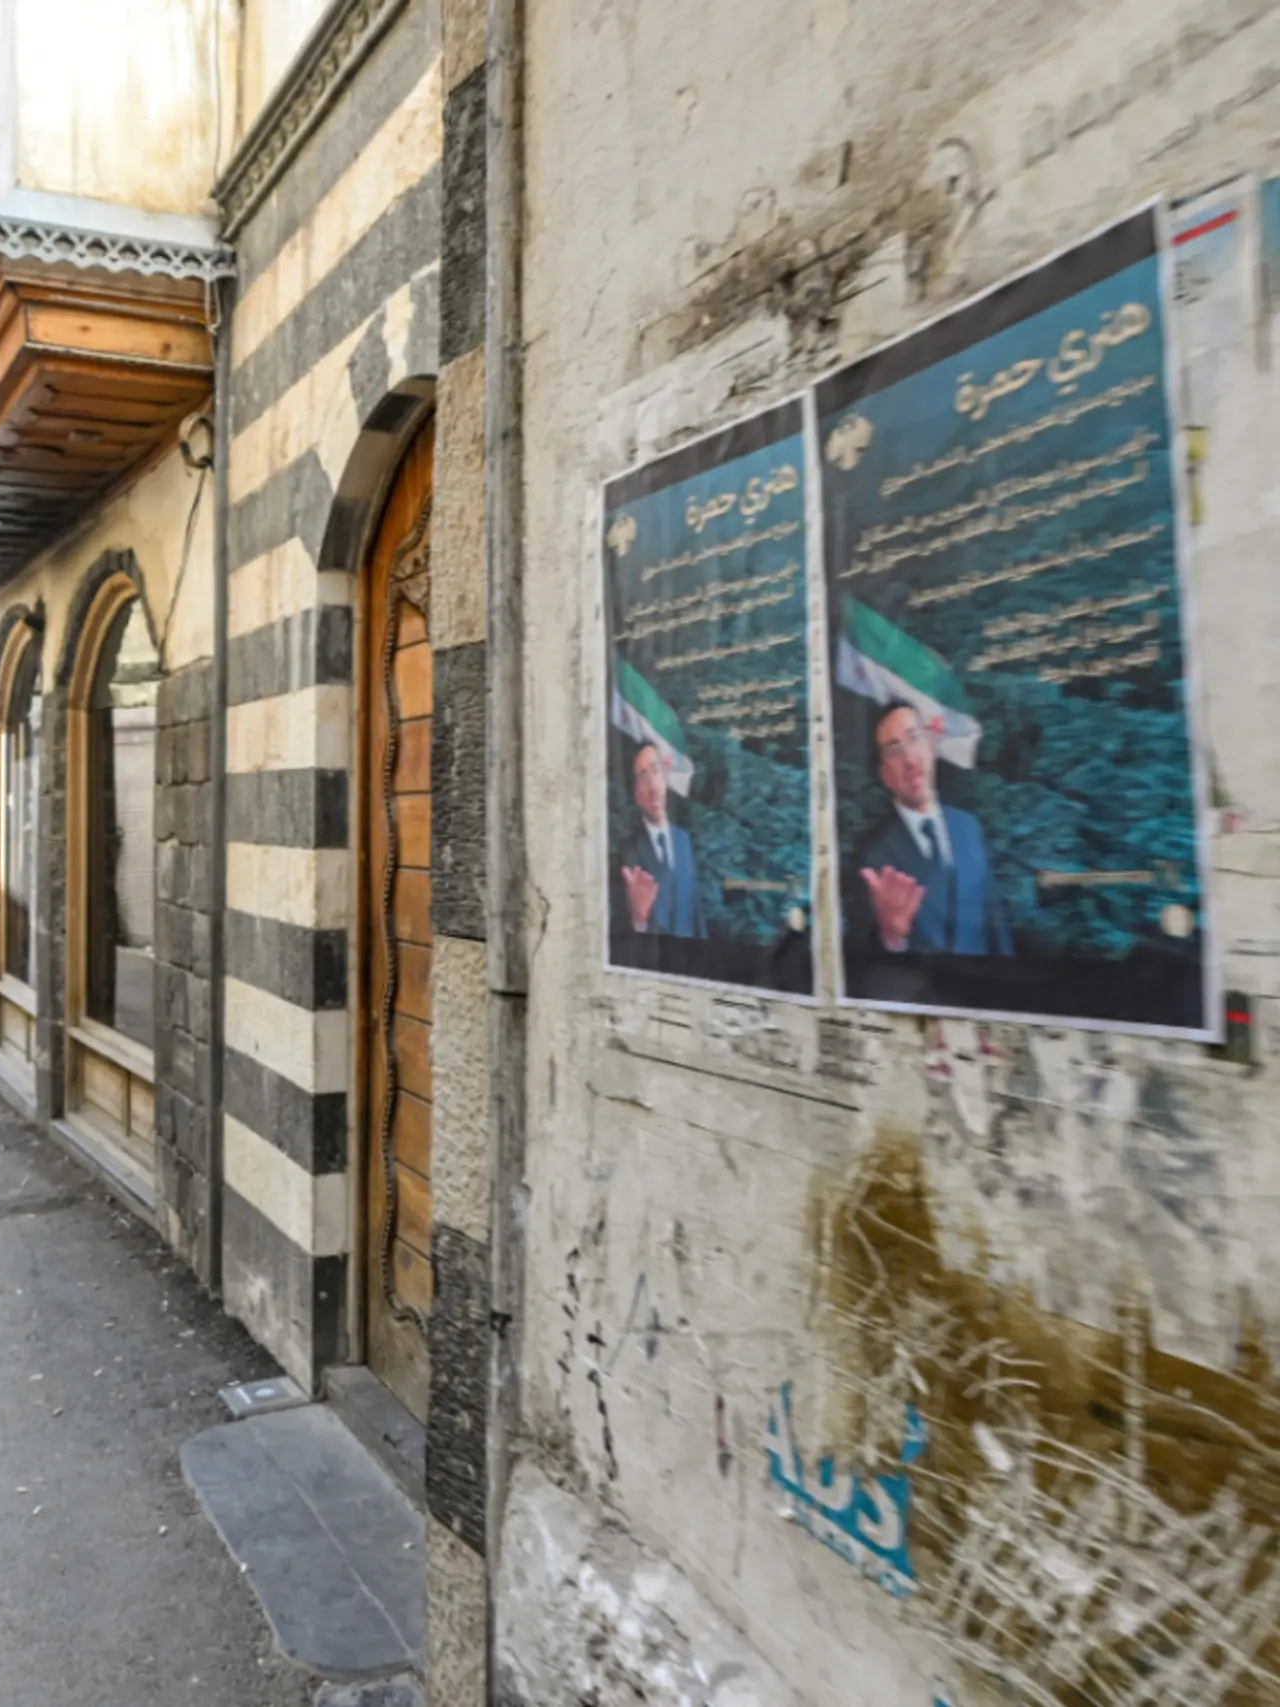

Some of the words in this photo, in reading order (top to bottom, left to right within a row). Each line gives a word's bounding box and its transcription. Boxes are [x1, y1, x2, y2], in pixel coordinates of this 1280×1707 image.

[1047, 302, 1151, 396] هنري
[954, 358, 1044, 421] حمرة
[686, 493, 737, 533] حمرة
[739, 464, 799, 525] هنري
